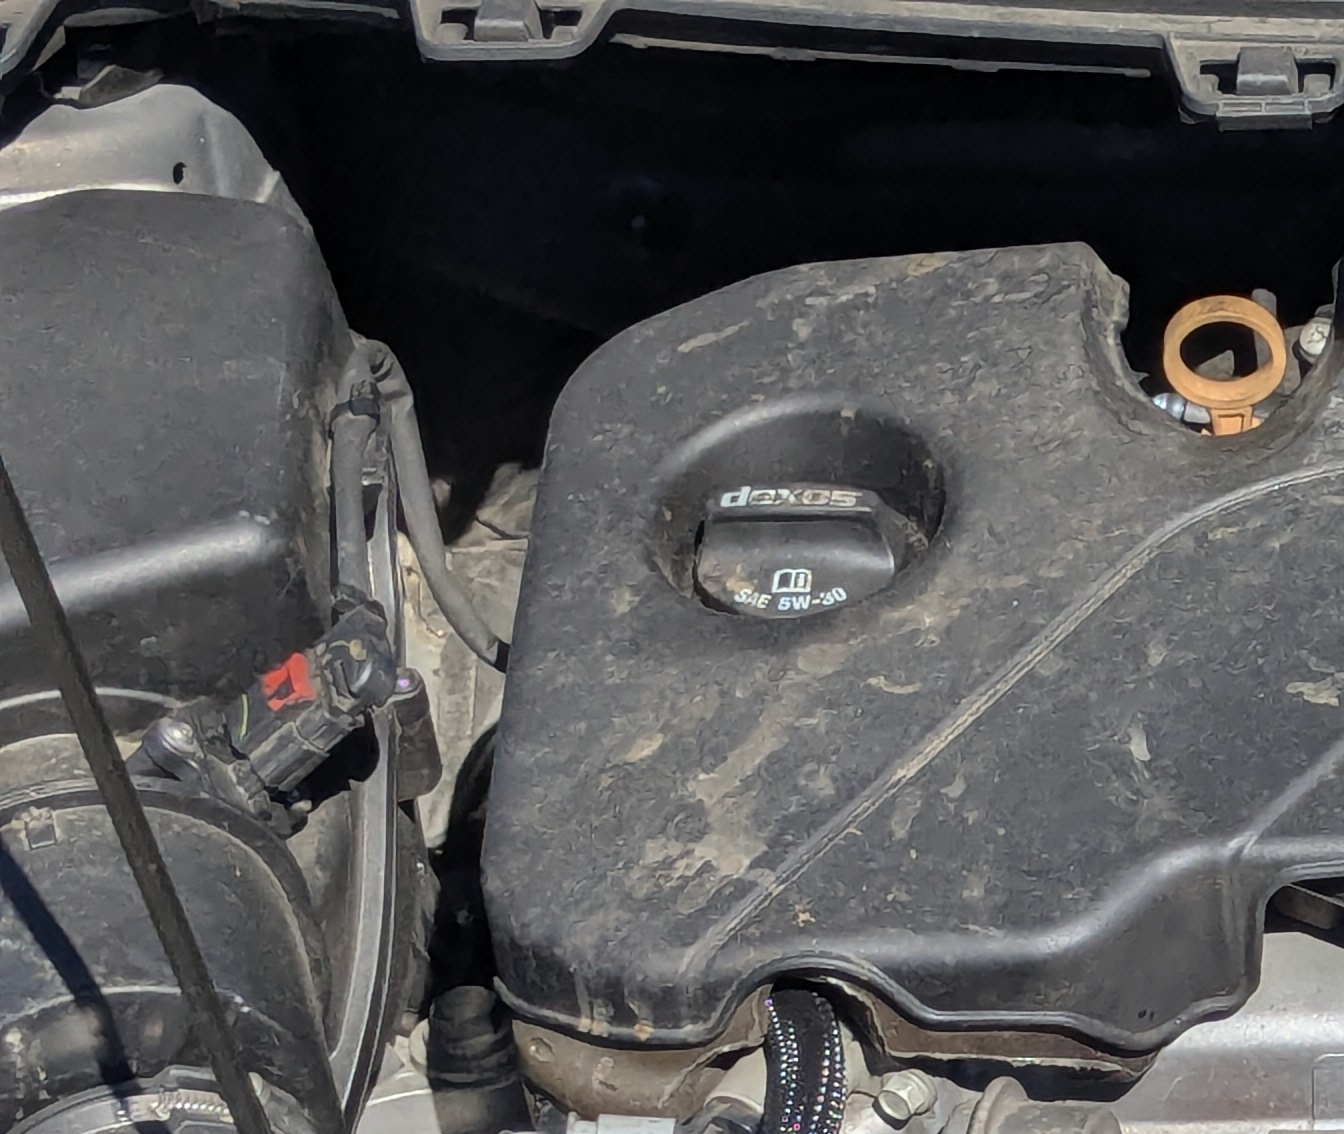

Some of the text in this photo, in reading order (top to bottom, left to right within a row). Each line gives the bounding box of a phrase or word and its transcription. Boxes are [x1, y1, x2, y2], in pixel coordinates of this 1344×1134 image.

[719, 486, 864, 508] dexos
[733, 587, 848, 611] SAE 5W-30
